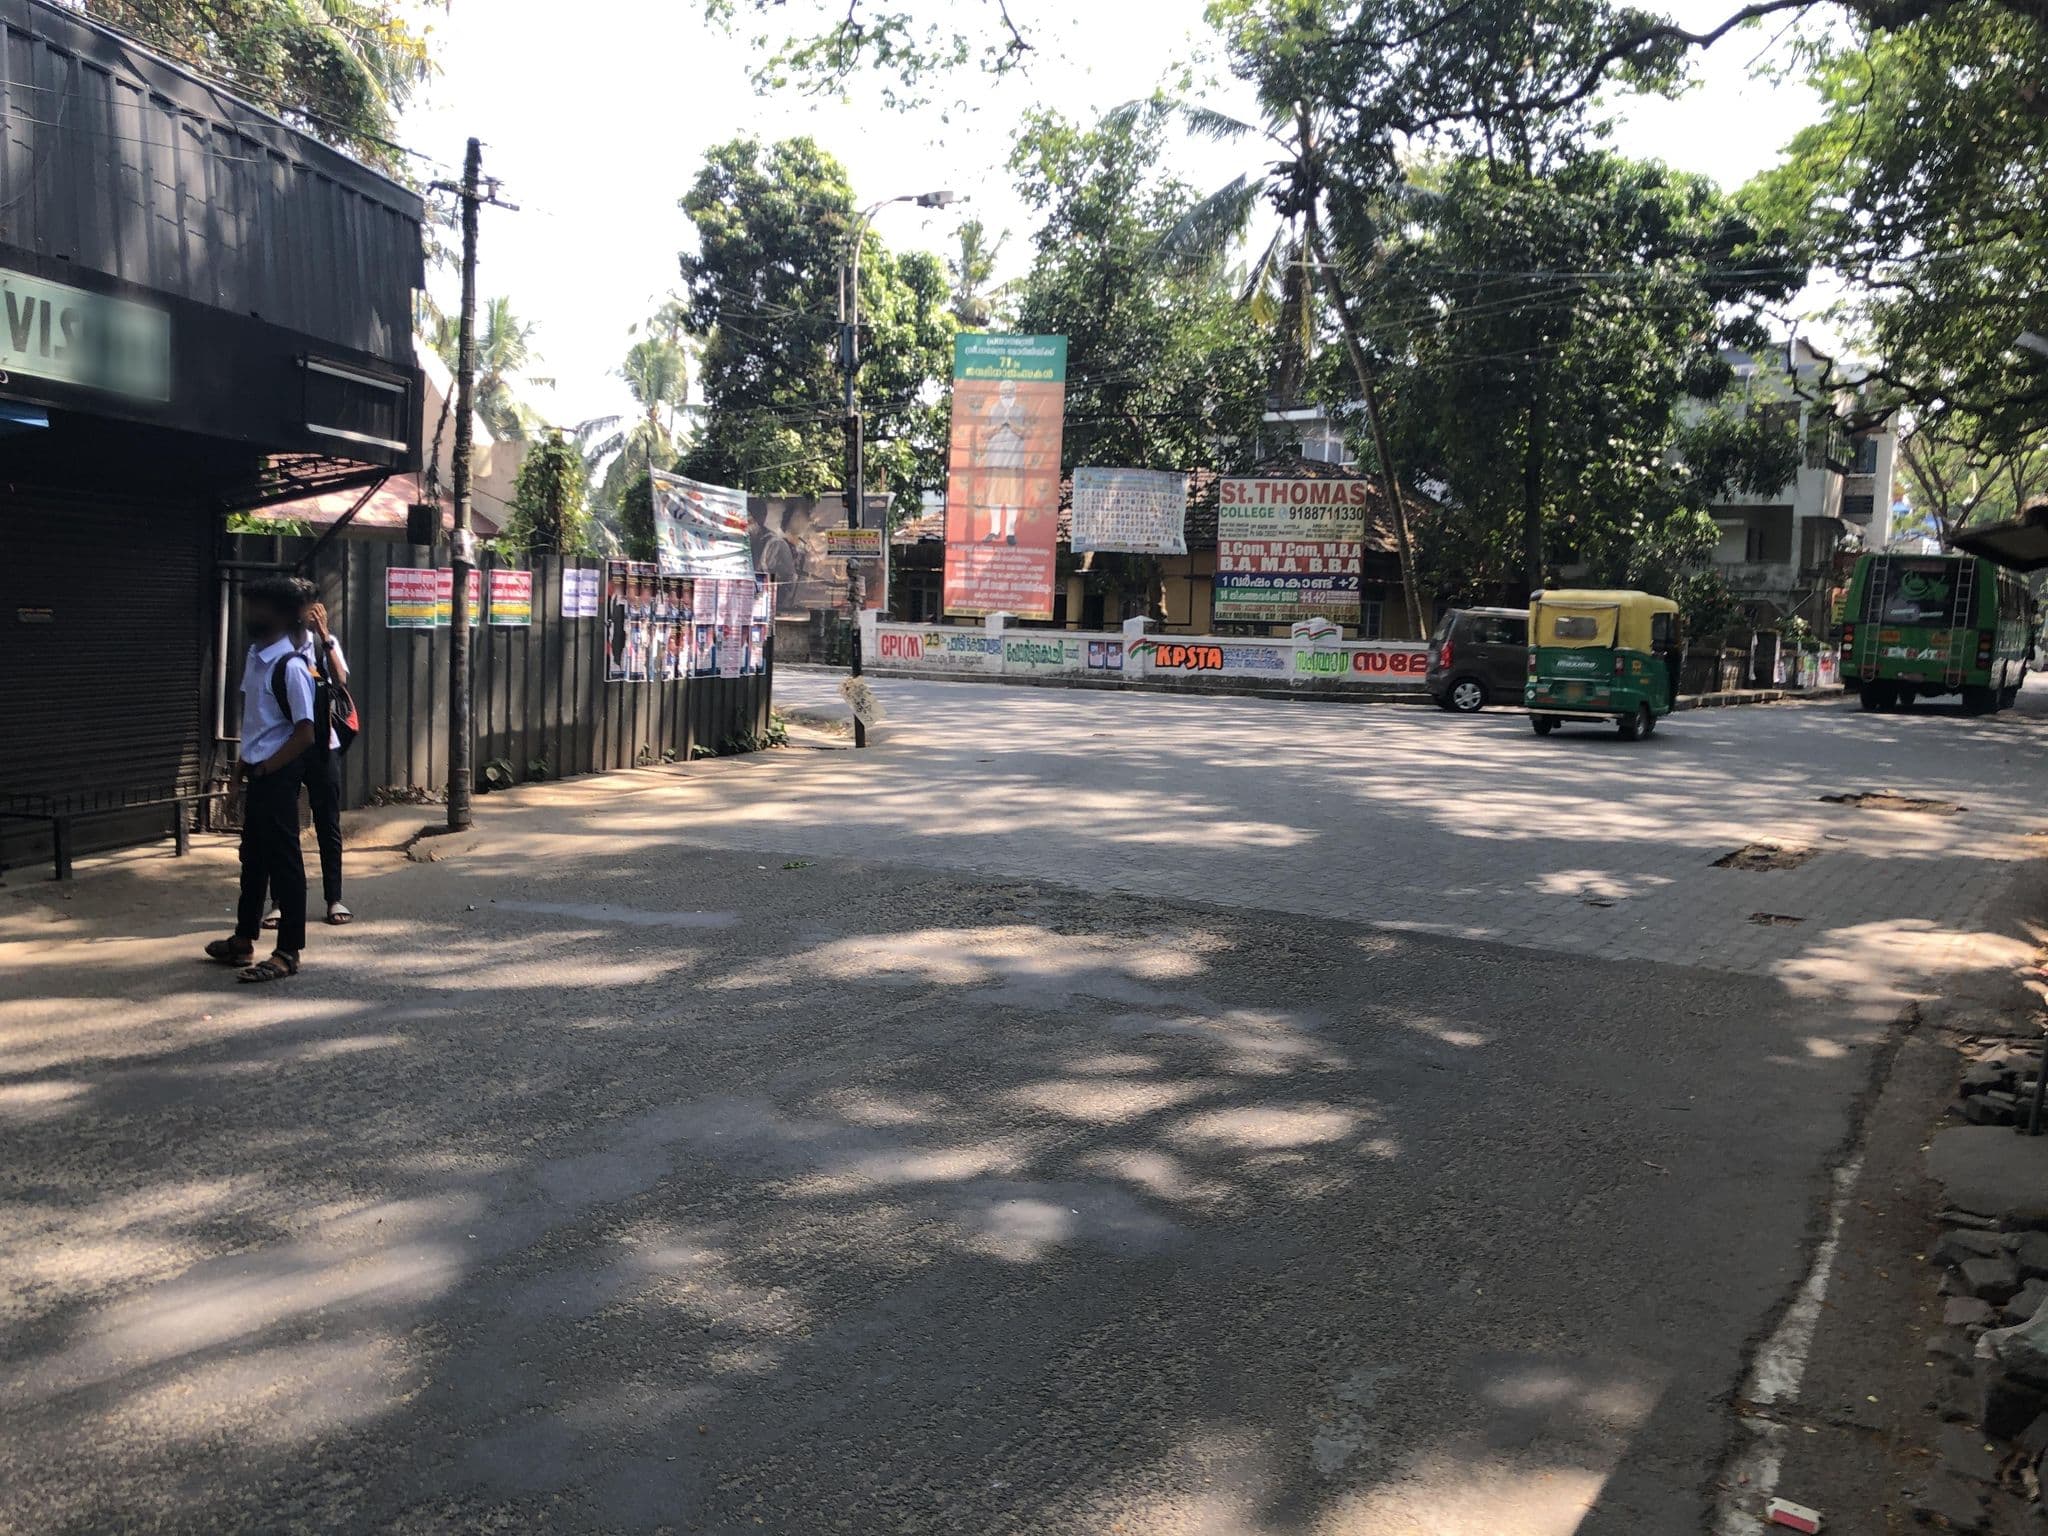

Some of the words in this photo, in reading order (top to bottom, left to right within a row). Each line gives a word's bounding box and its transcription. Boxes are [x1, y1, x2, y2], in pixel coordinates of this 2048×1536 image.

[1220, 506, 1275, 519] COLLEGE
[1289, 506, 1364, 520] 9188711330
[1323, 544, 1362, 558] M.B.A
[1309, 558, 1361, 573] B.B.A
[1222, 576, 1228, 587] 1
[1231, 575, 1271, 588] വർഷം
[1338, 577, 1359, 590] +2
[881, 634, 924, 661] CPI(M)
[1155, 643, 1223, 670] KPSTA
